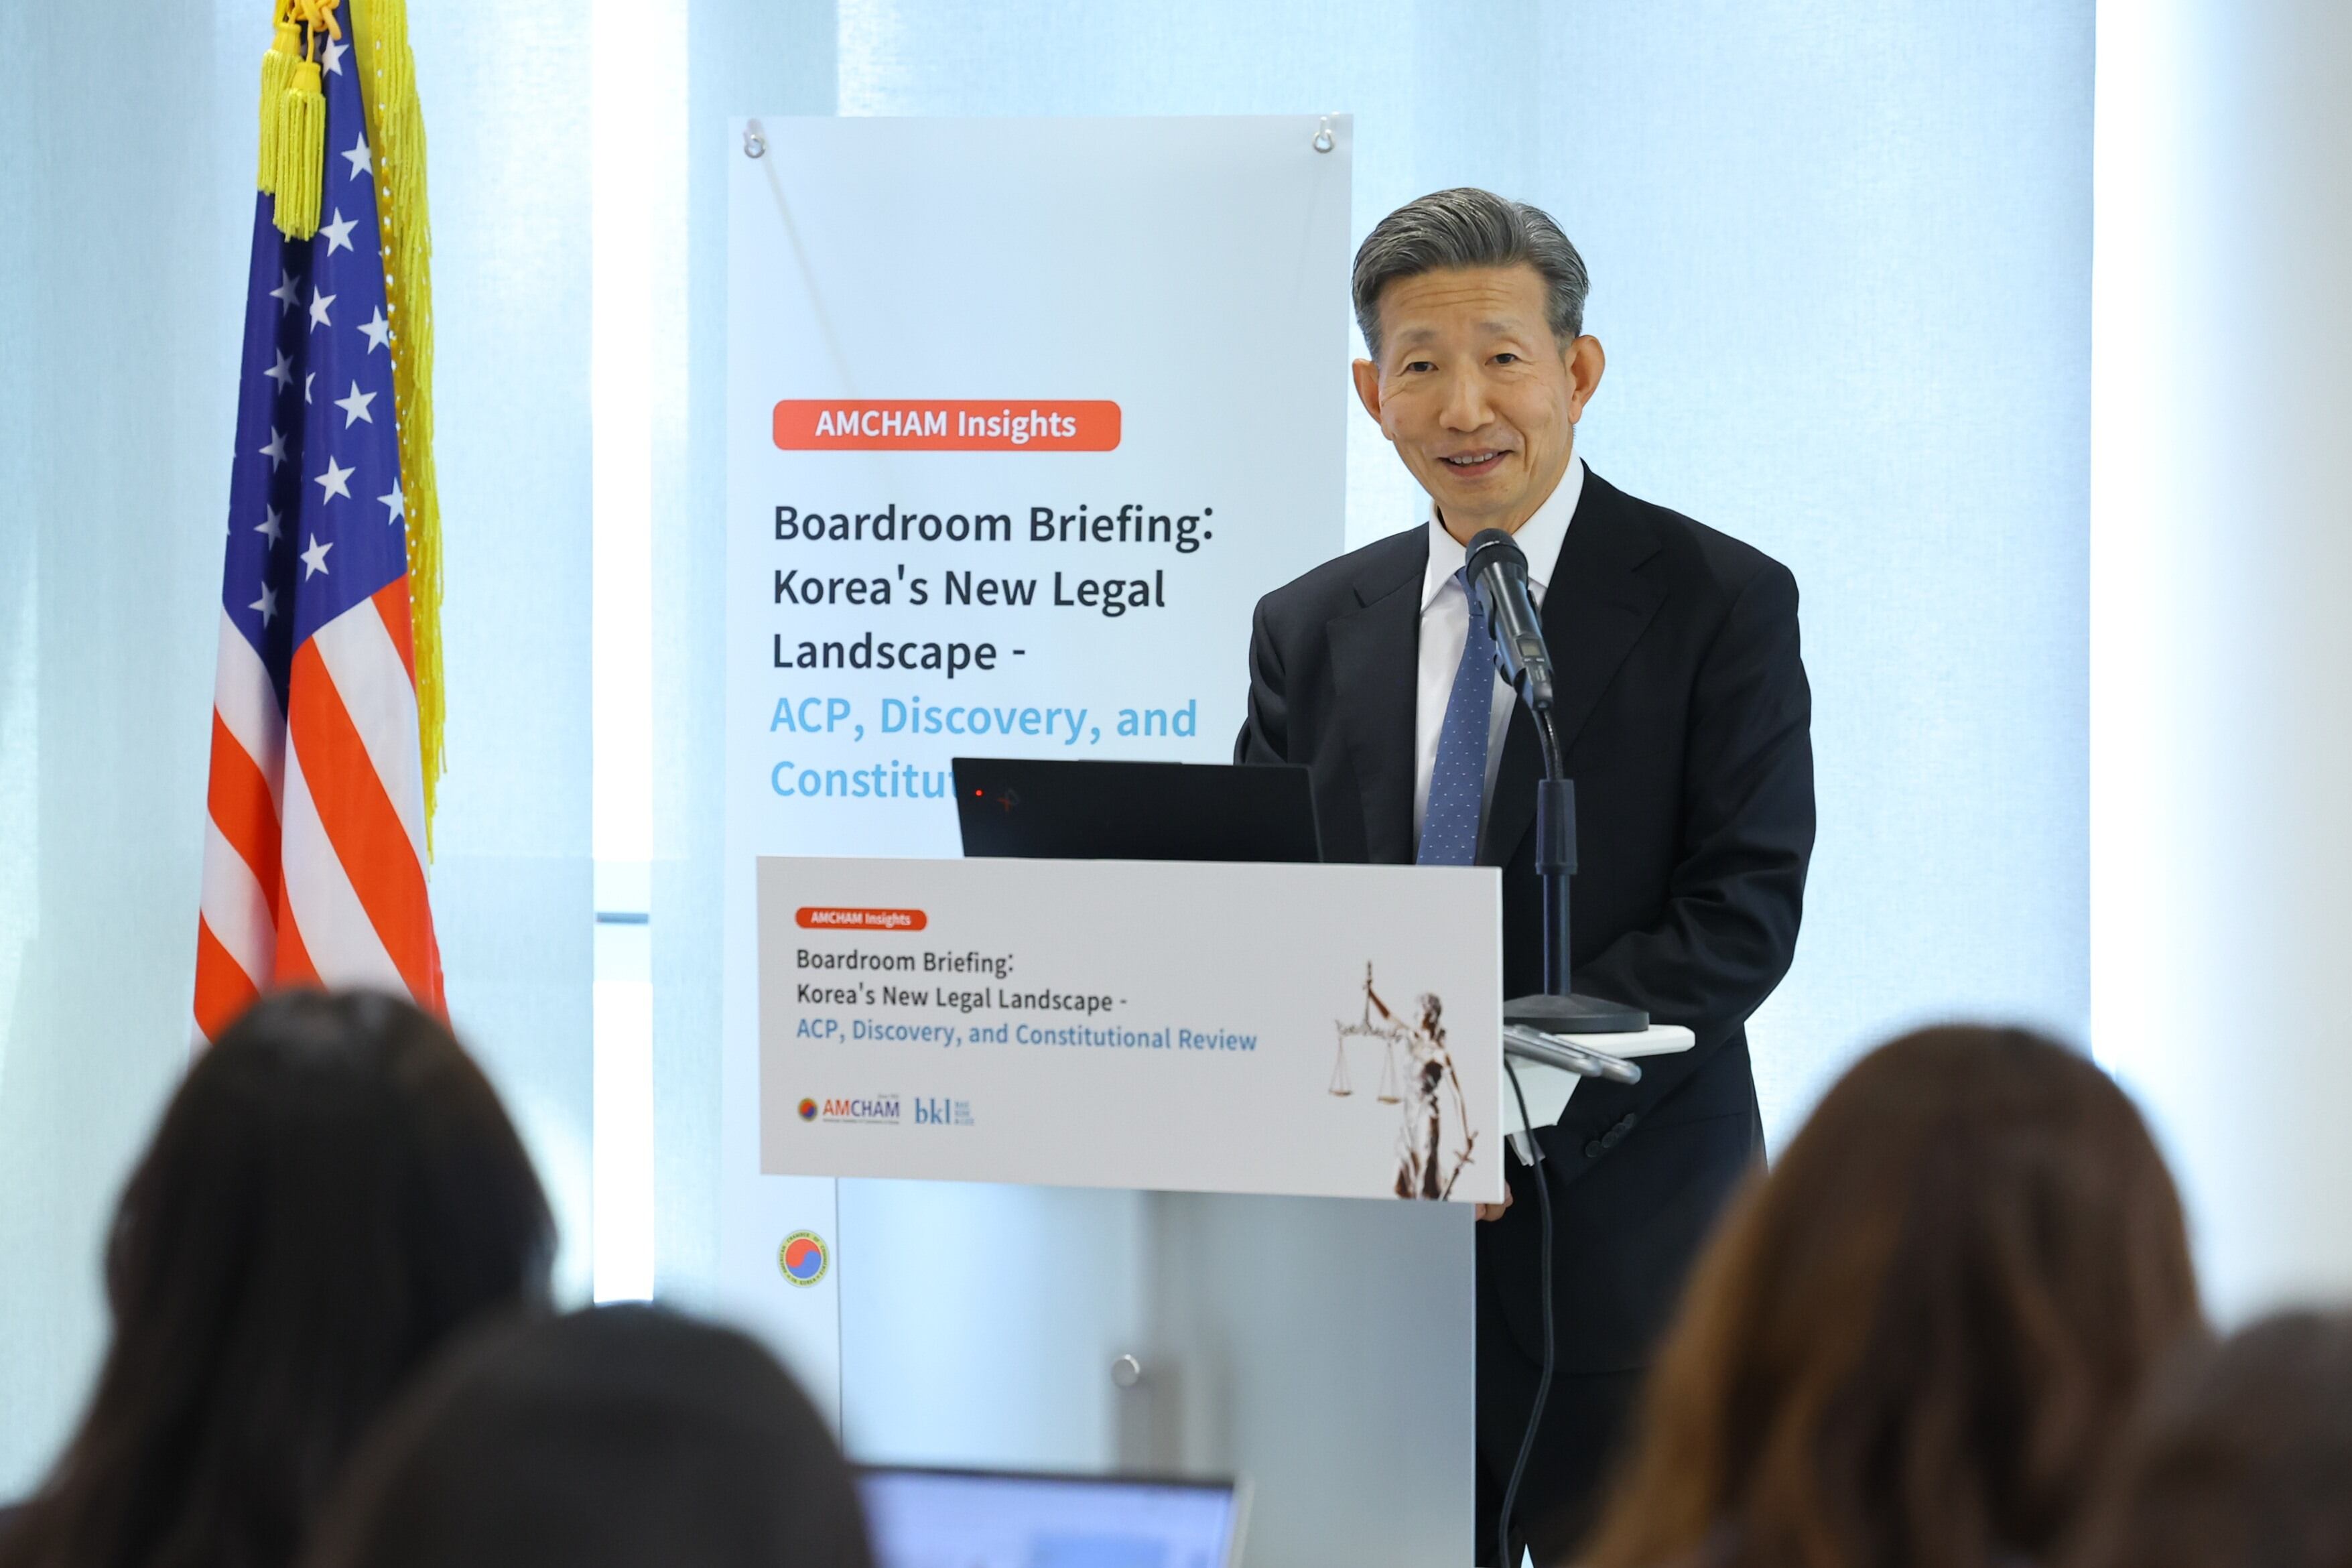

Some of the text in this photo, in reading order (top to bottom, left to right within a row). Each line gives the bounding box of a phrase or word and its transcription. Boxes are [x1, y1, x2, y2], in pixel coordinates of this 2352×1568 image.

[815, 409, 1075, 444] AMCHAM Insights
[775, 504, 1213, 553] Boardroom Briefing:
[775, 564, 1165, 617] Korea's New Legal
[774, 632, 997, 679] Landscape
[770, 696, 1196, 745] ACP, Discovery, and
[811, 911, 911, 928] AMCHAM Insights
[797, 950, 1012, 979] Boardroom Briefing:
[798, 982, 874, 1004] Korea's
[884, 987, 927, 1005] New
[937, 988, 990, 1013] Legal
[1000, 989, 1112, 1015] Landscape
[797, 1019, 1256, 1050] ACP, Discovery, and Constitutional Review
[824, 1100, 899, 1116] AMCHAM
[916, 1098, 950, 1123] bkl
